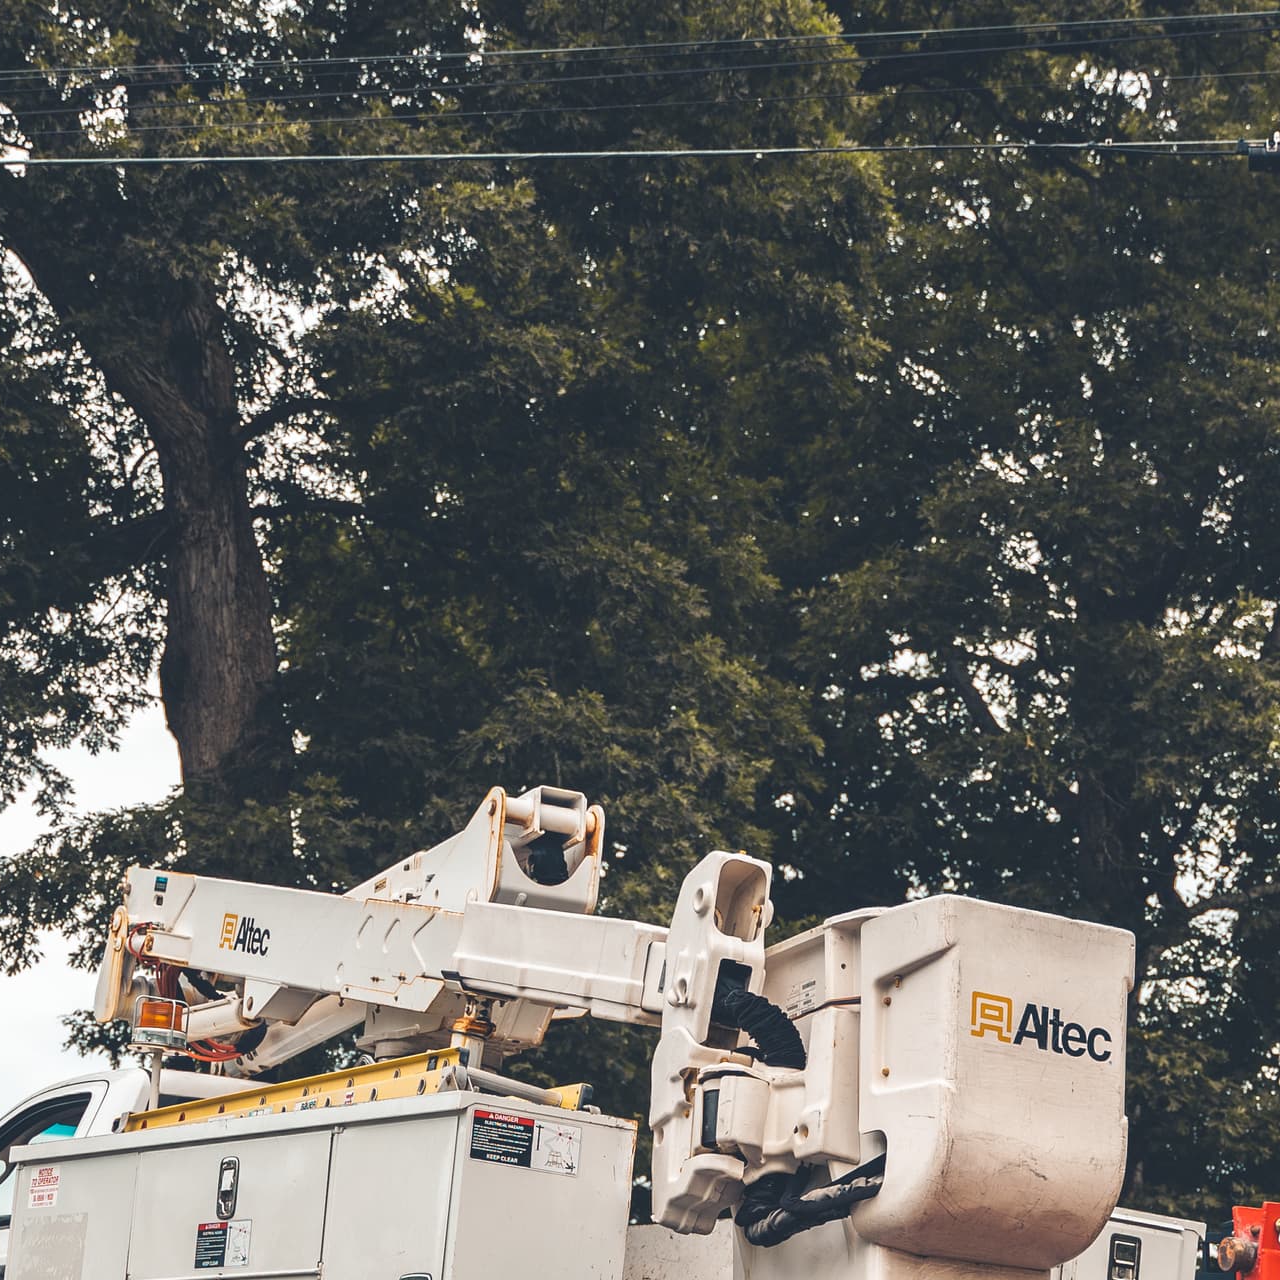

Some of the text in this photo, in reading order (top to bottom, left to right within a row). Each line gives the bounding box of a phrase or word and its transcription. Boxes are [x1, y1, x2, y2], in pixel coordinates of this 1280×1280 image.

[233, 916, 270, 956] Altec
[1013, 1002, 1112, 1062] Altec
[494, 1113, 519, 1124] DANGER
[486, 1153, 518, 1164] KEEP CLEAR
